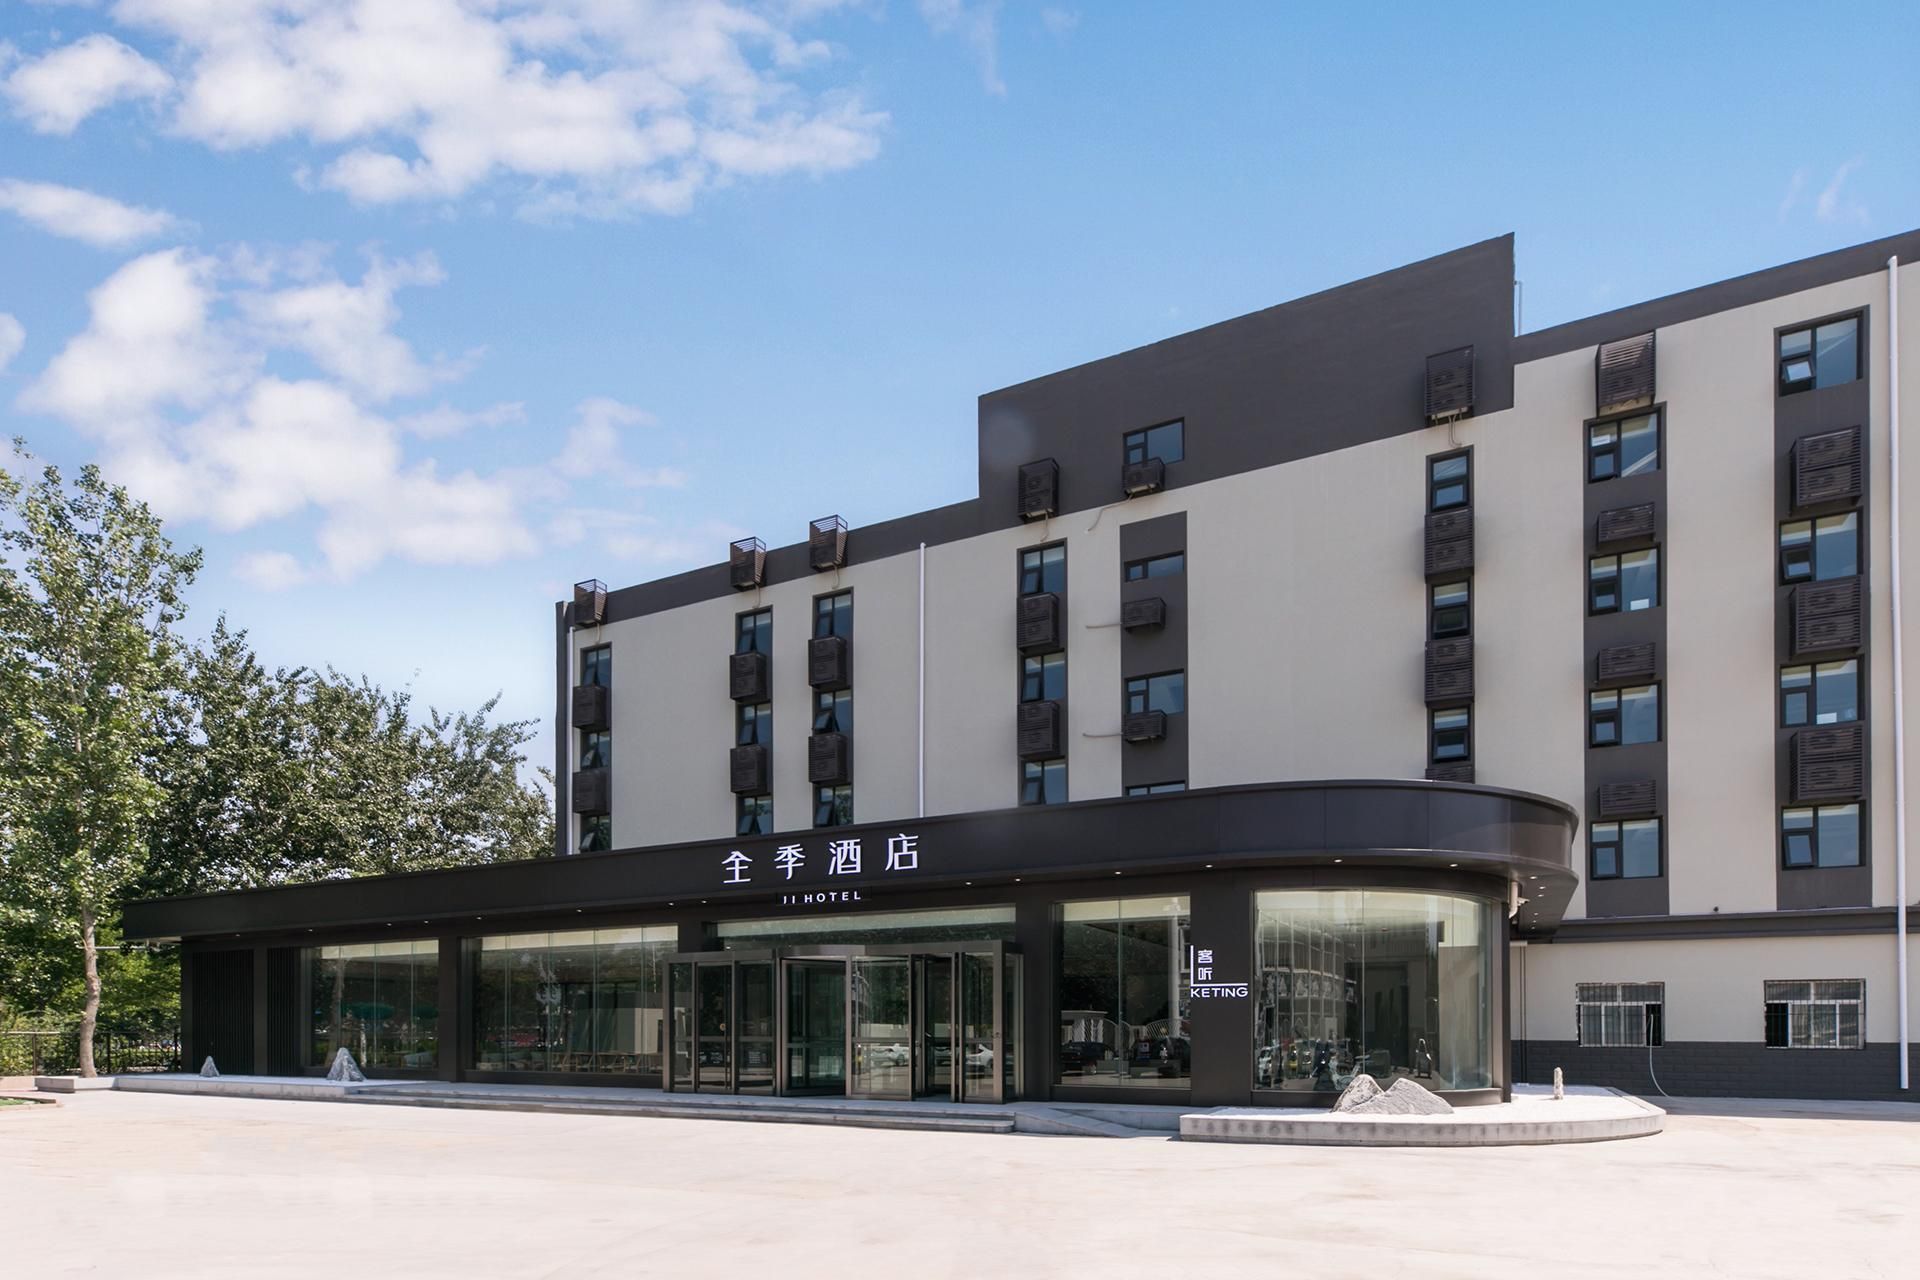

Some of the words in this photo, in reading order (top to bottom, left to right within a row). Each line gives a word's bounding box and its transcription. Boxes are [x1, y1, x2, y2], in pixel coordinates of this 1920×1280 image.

[721, 833, 919, 884] 全季酒店
[783, 894, 796, 905] JI
[804, 891, 862, 904] HOTEL
[1190, 987, 1249, 998] KETING
